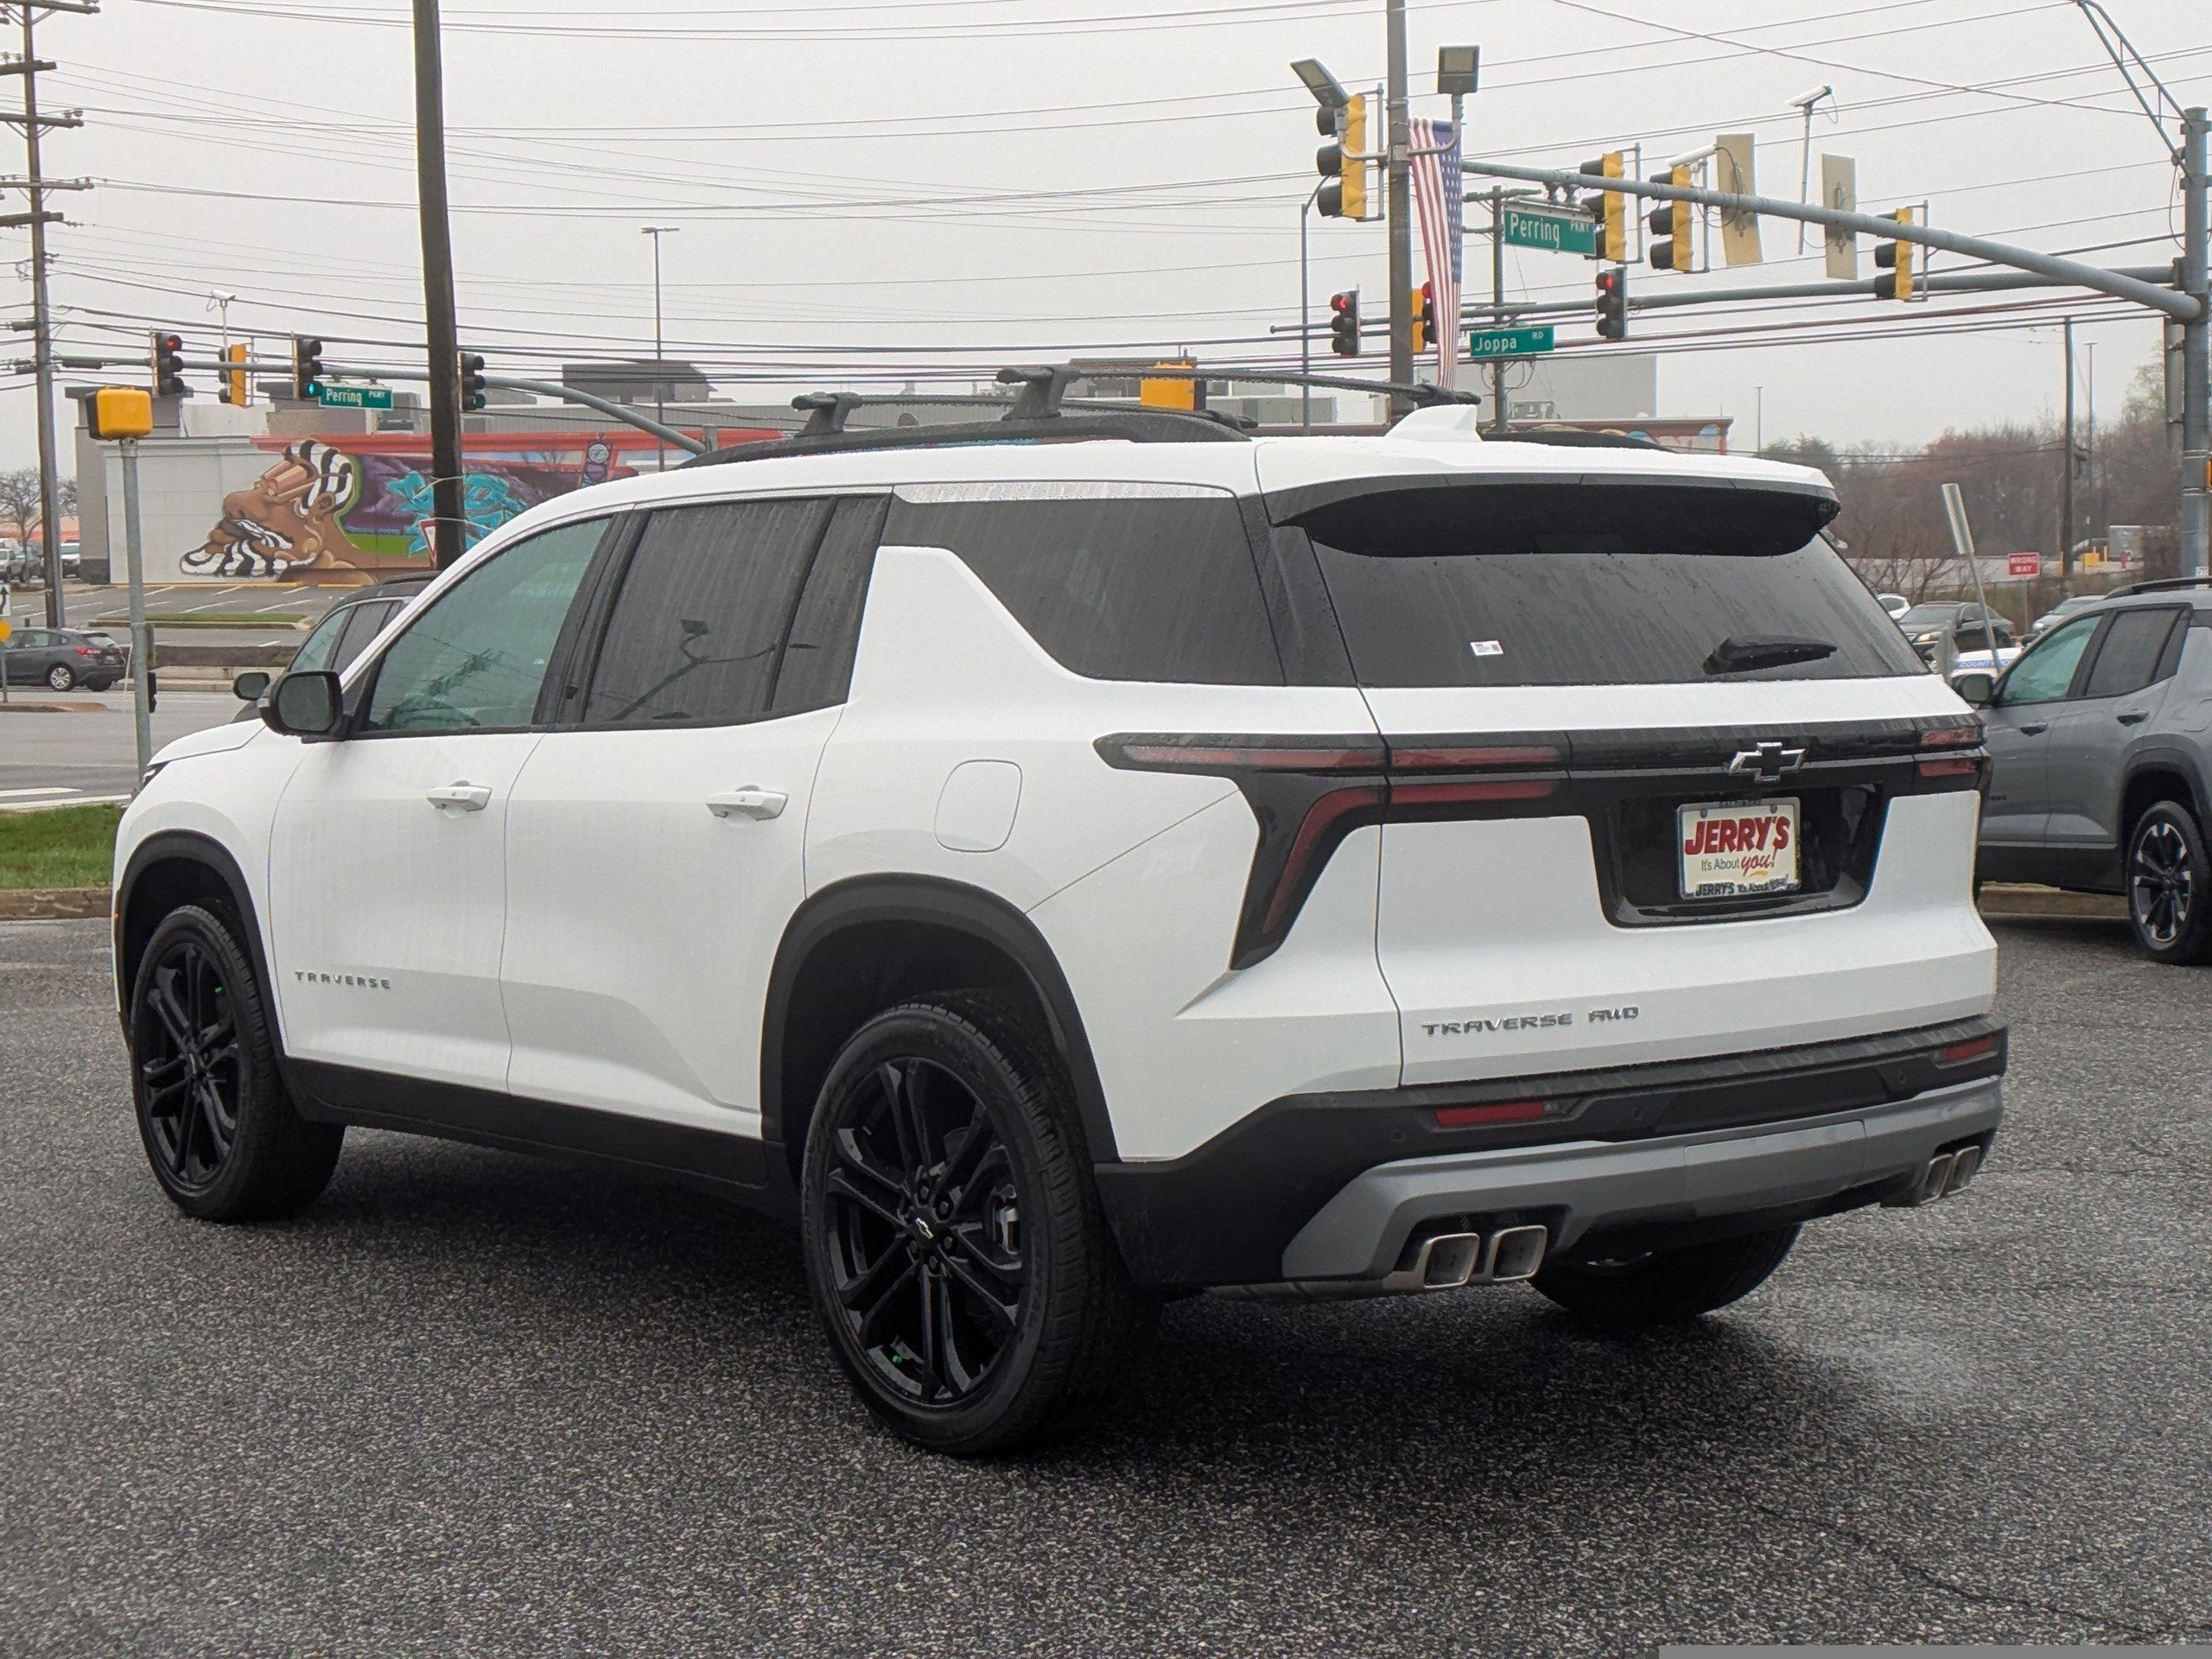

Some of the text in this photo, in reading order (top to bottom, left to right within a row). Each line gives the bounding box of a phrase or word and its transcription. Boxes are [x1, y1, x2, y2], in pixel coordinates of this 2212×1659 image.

[1510, 212, 1560, 249] Perring
[1475, 331, 1544, 353] Joppa RD
[326, 388, 363, 407] Perring
[1685, 816, 1792, 855] JERRY'S
[1700, 847, 1777, 877] It's About you!
[294, 970, 391, 990] TRAVERSE
[1421, 1006, 1640, 1037] TRAVERSE AWD
